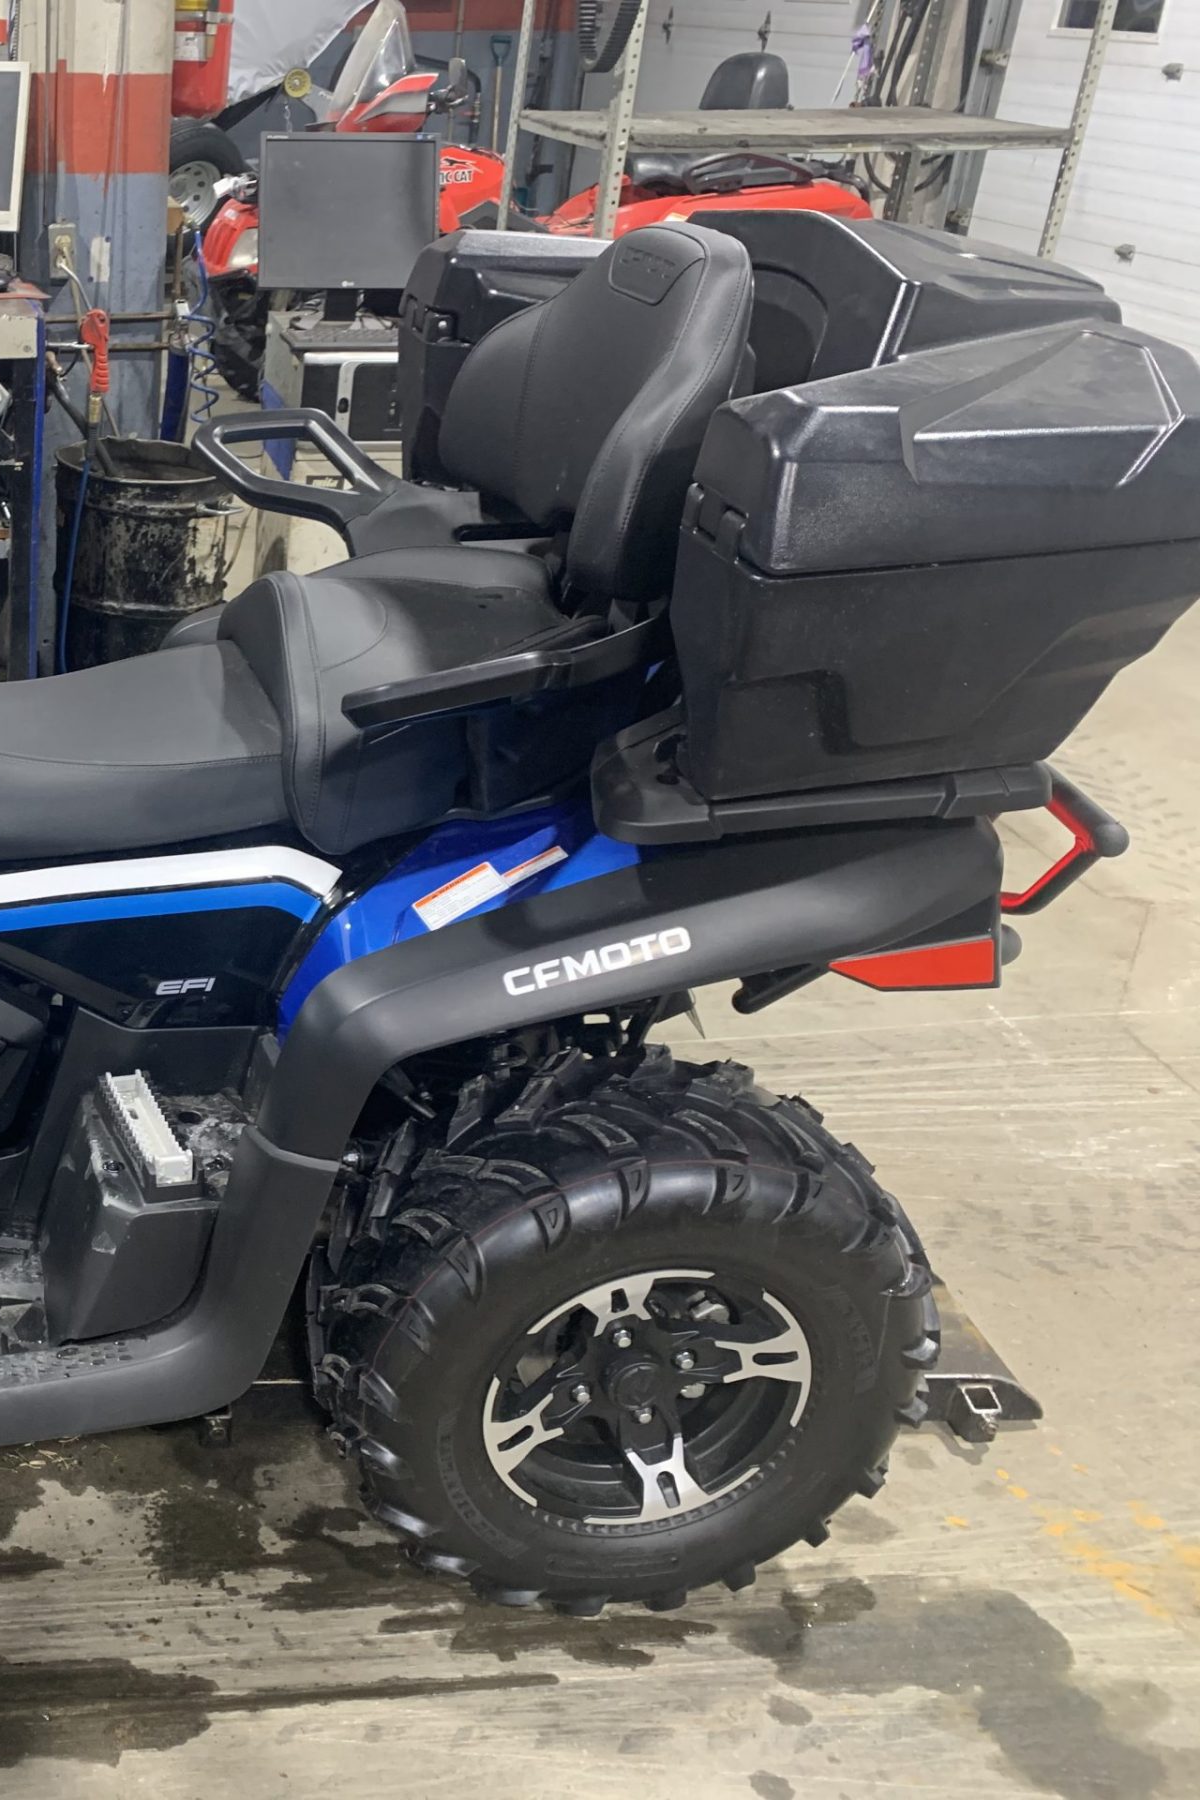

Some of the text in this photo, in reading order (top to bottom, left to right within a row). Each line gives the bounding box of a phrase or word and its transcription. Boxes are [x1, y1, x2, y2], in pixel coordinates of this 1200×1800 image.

[454, 170, 473, 182] CAT
[503, 927, 692, 996] CFMOTO
[155, 977, 217, 996] EFI
